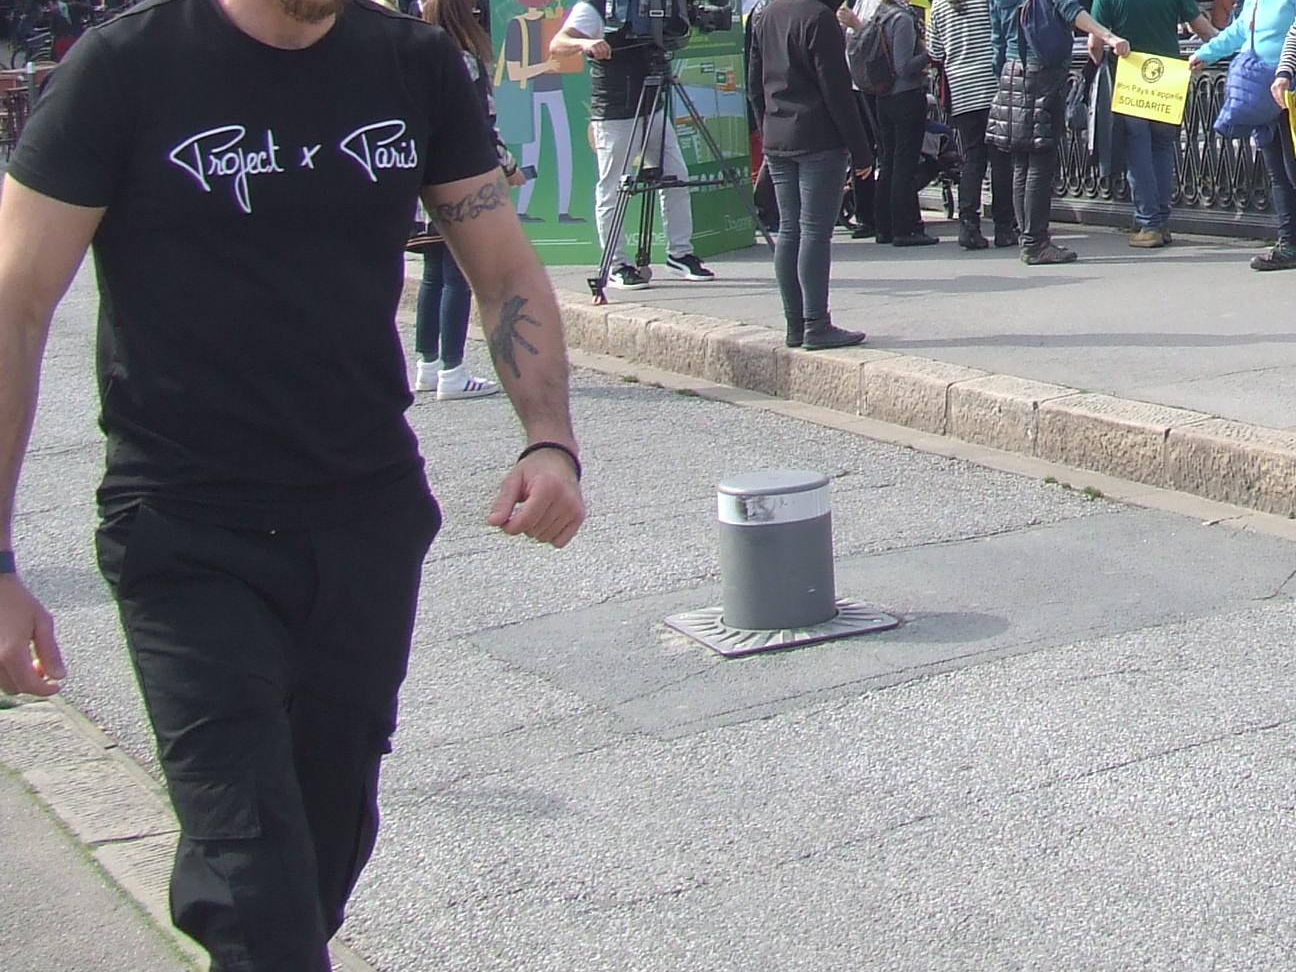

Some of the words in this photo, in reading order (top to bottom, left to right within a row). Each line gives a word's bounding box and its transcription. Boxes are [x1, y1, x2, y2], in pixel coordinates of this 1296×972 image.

[1117, 81, 1130, 91] Mon
[1131, 84, 1149, 96] Pays
[169, 125, 285, 214] Project
[339, 119, 420, 182] Paris
